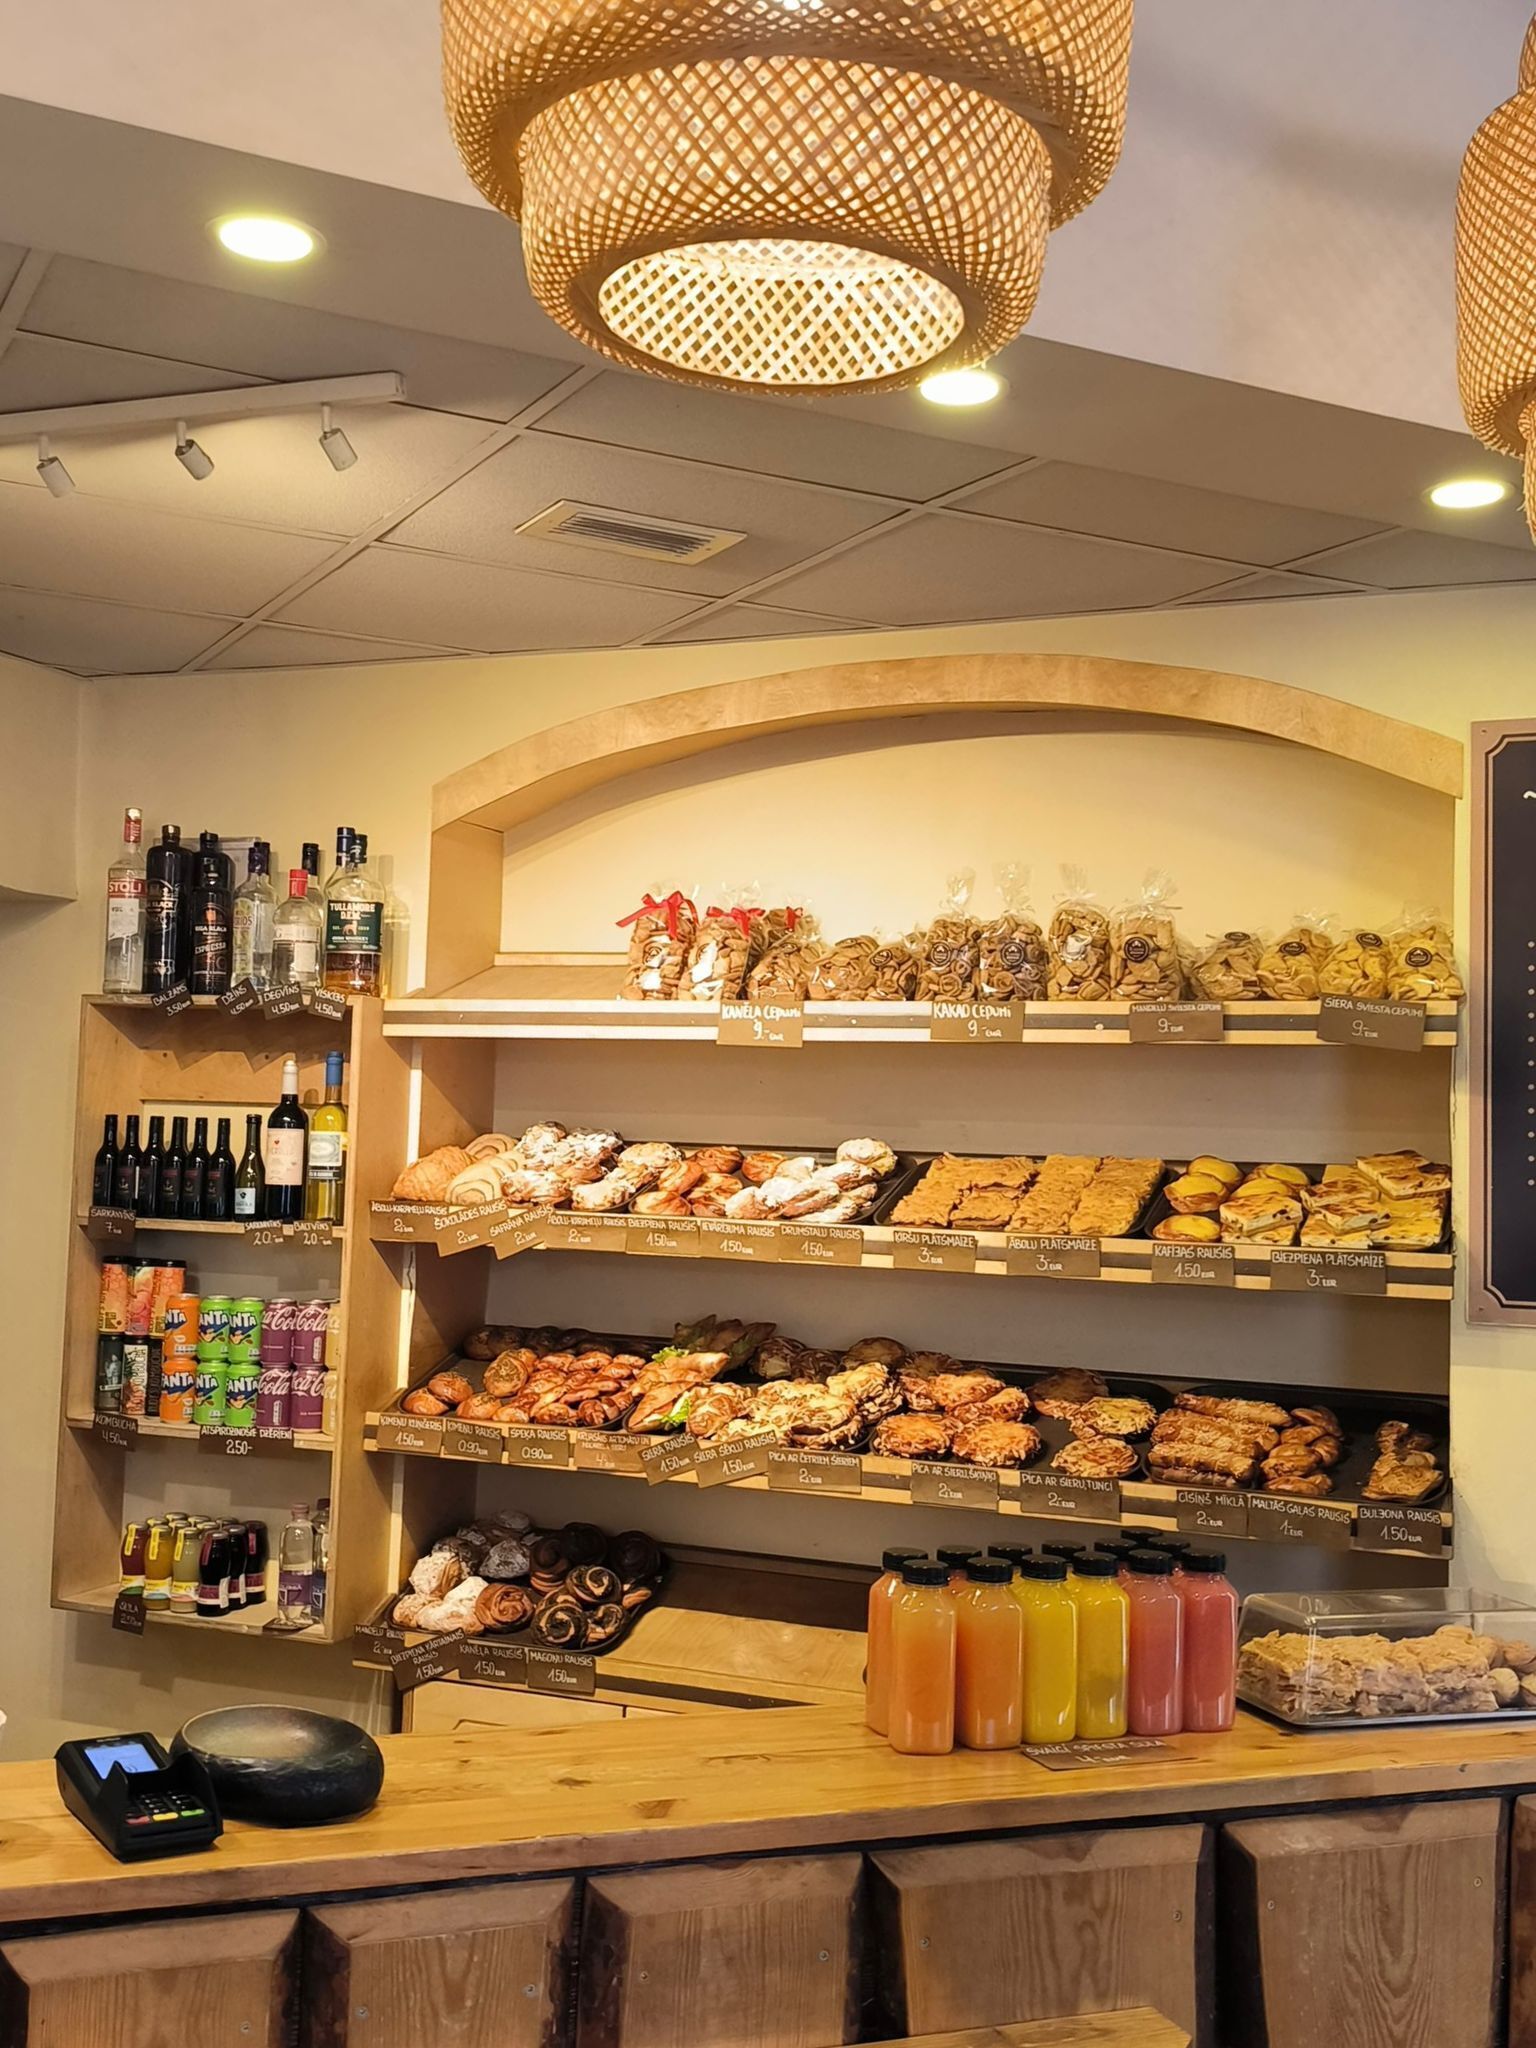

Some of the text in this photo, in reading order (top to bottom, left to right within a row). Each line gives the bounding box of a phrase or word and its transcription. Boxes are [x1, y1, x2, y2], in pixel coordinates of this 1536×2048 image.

[108, 881, 142, 893] STOLI
[330, 902, 375, 912] TULLAMORE
[153, 984, 187, 1006] BALZAMS
[1324, 996, 1353, 1010] SIERA
[1356, 1001, 1390, 1015] SVIESTA
[479, 1199, 507, 1216] RAUSIS
[524, 1204, 554, 1224] RAUSIS
[668, 1220, 697, 1232] RAUSIS
[747, 1226, 776, 1238] RAUSIS
[829, 1228, 861, 1240] RAUSIS
[1008, 1236, 1037, 1250] ĀBOLU
[1197, 1246, 1233, 1260] RAUSIS
[1271, 1251, 1323, 1265] BIEZPIENA
[95, 1413, 137, 1431] KOMBUCHA
[474, 1425, 500, 1440] RAUSIS
[537, 1430, 567, 1442] RAUSIS
[641, 1433, 696, 1462] SIERA RAUSIS
[693, 1449, 718, 1464] SIERA
[744, 1432, 777, 1450] RAUSIS
[768, 1451, 786, 1463] PICA
[787, 1453, 799, 1463] AR
[912, 1463, 930, 1476] PICA
[931, 1466, 943, 1476] AR
[1021, 1473, 1041, 1485] PICA
[1044, 1476, 1057, 1486] AR
[1215, 1493, 1244, 1508] MĪKLĀ
[1252, 1498, 1285, 1513] MALTĀS
[1318, 1508, 1350, 1524] RAUSIS
[1407, 1510, 1441, 1525] RAUSIS
[493, 1646, 523, 1660] RAUSIS
[565, 1653, 592, 1667] RAUSIS
